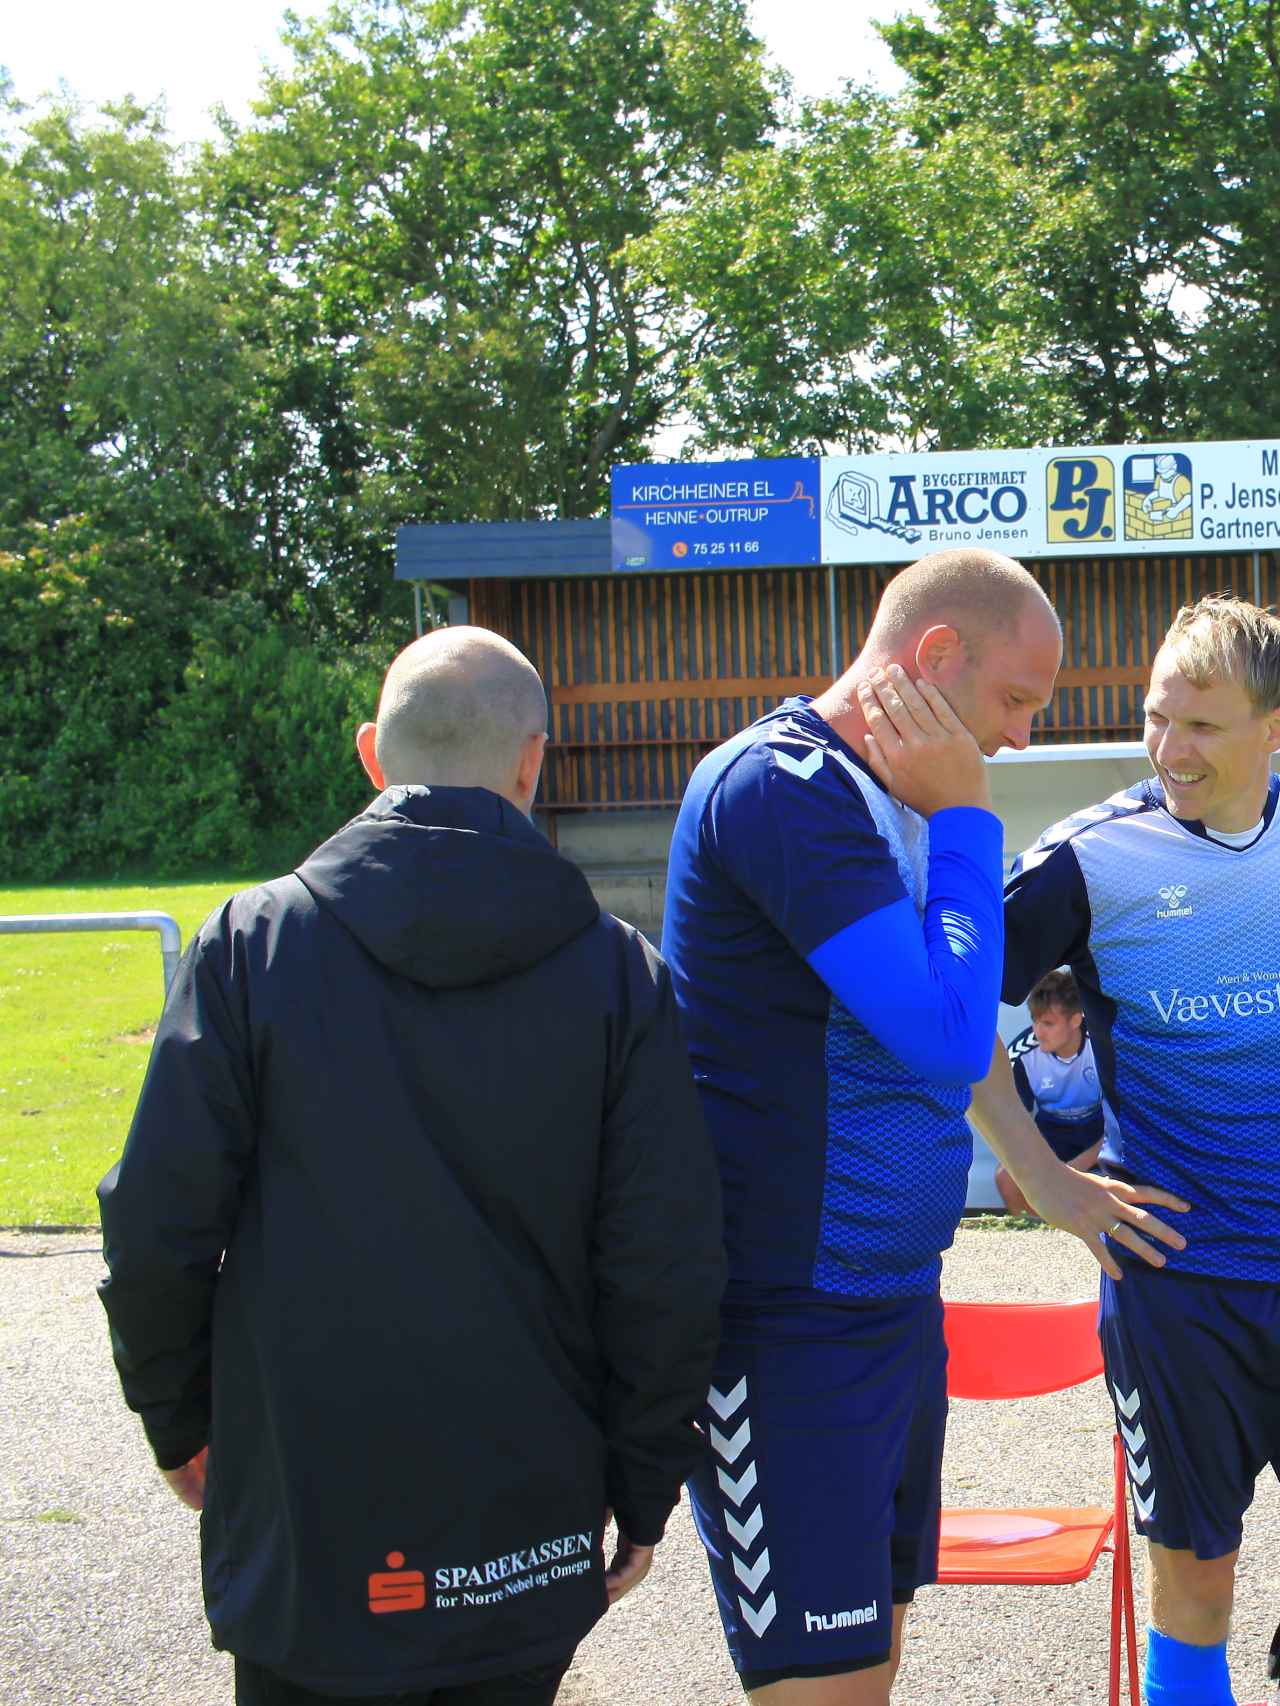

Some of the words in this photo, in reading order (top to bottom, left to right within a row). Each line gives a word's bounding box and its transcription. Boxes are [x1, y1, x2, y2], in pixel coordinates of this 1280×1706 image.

[922, 471, 1027, 487] BYGGEFIRMAET
[632, 483, 751, 502] KIRCHHEINER
[755, 481, 775, 498] EL
[888, 475, 1028, 526] ARCO
[1200, 487, 1218, 509] P.
[929, 529, 971, 542] Bruno
[976, 527, 1029, 541] Jensen
[693, 542, 708, 555] 75
[710, 542, 726, 555] 25
[729, 542, 742, 554] 11
[744, 541, 760, 554] 66
[1156, 905, 1194, 920] hummel
[1216, 974, 1240, 986] Men
[435, 1532, 593, 1590] SPAREKASSEN
[436, 1594, 458, 1609] for
[463, 1590, 503, 1607] Nørre
[505, 1575, 534, 1597] Nebel
[535, 1572, 549, 1587] og
[551, 1558, 591, 1581] Omegn
[805, 1600, 878, 1632] hummel
